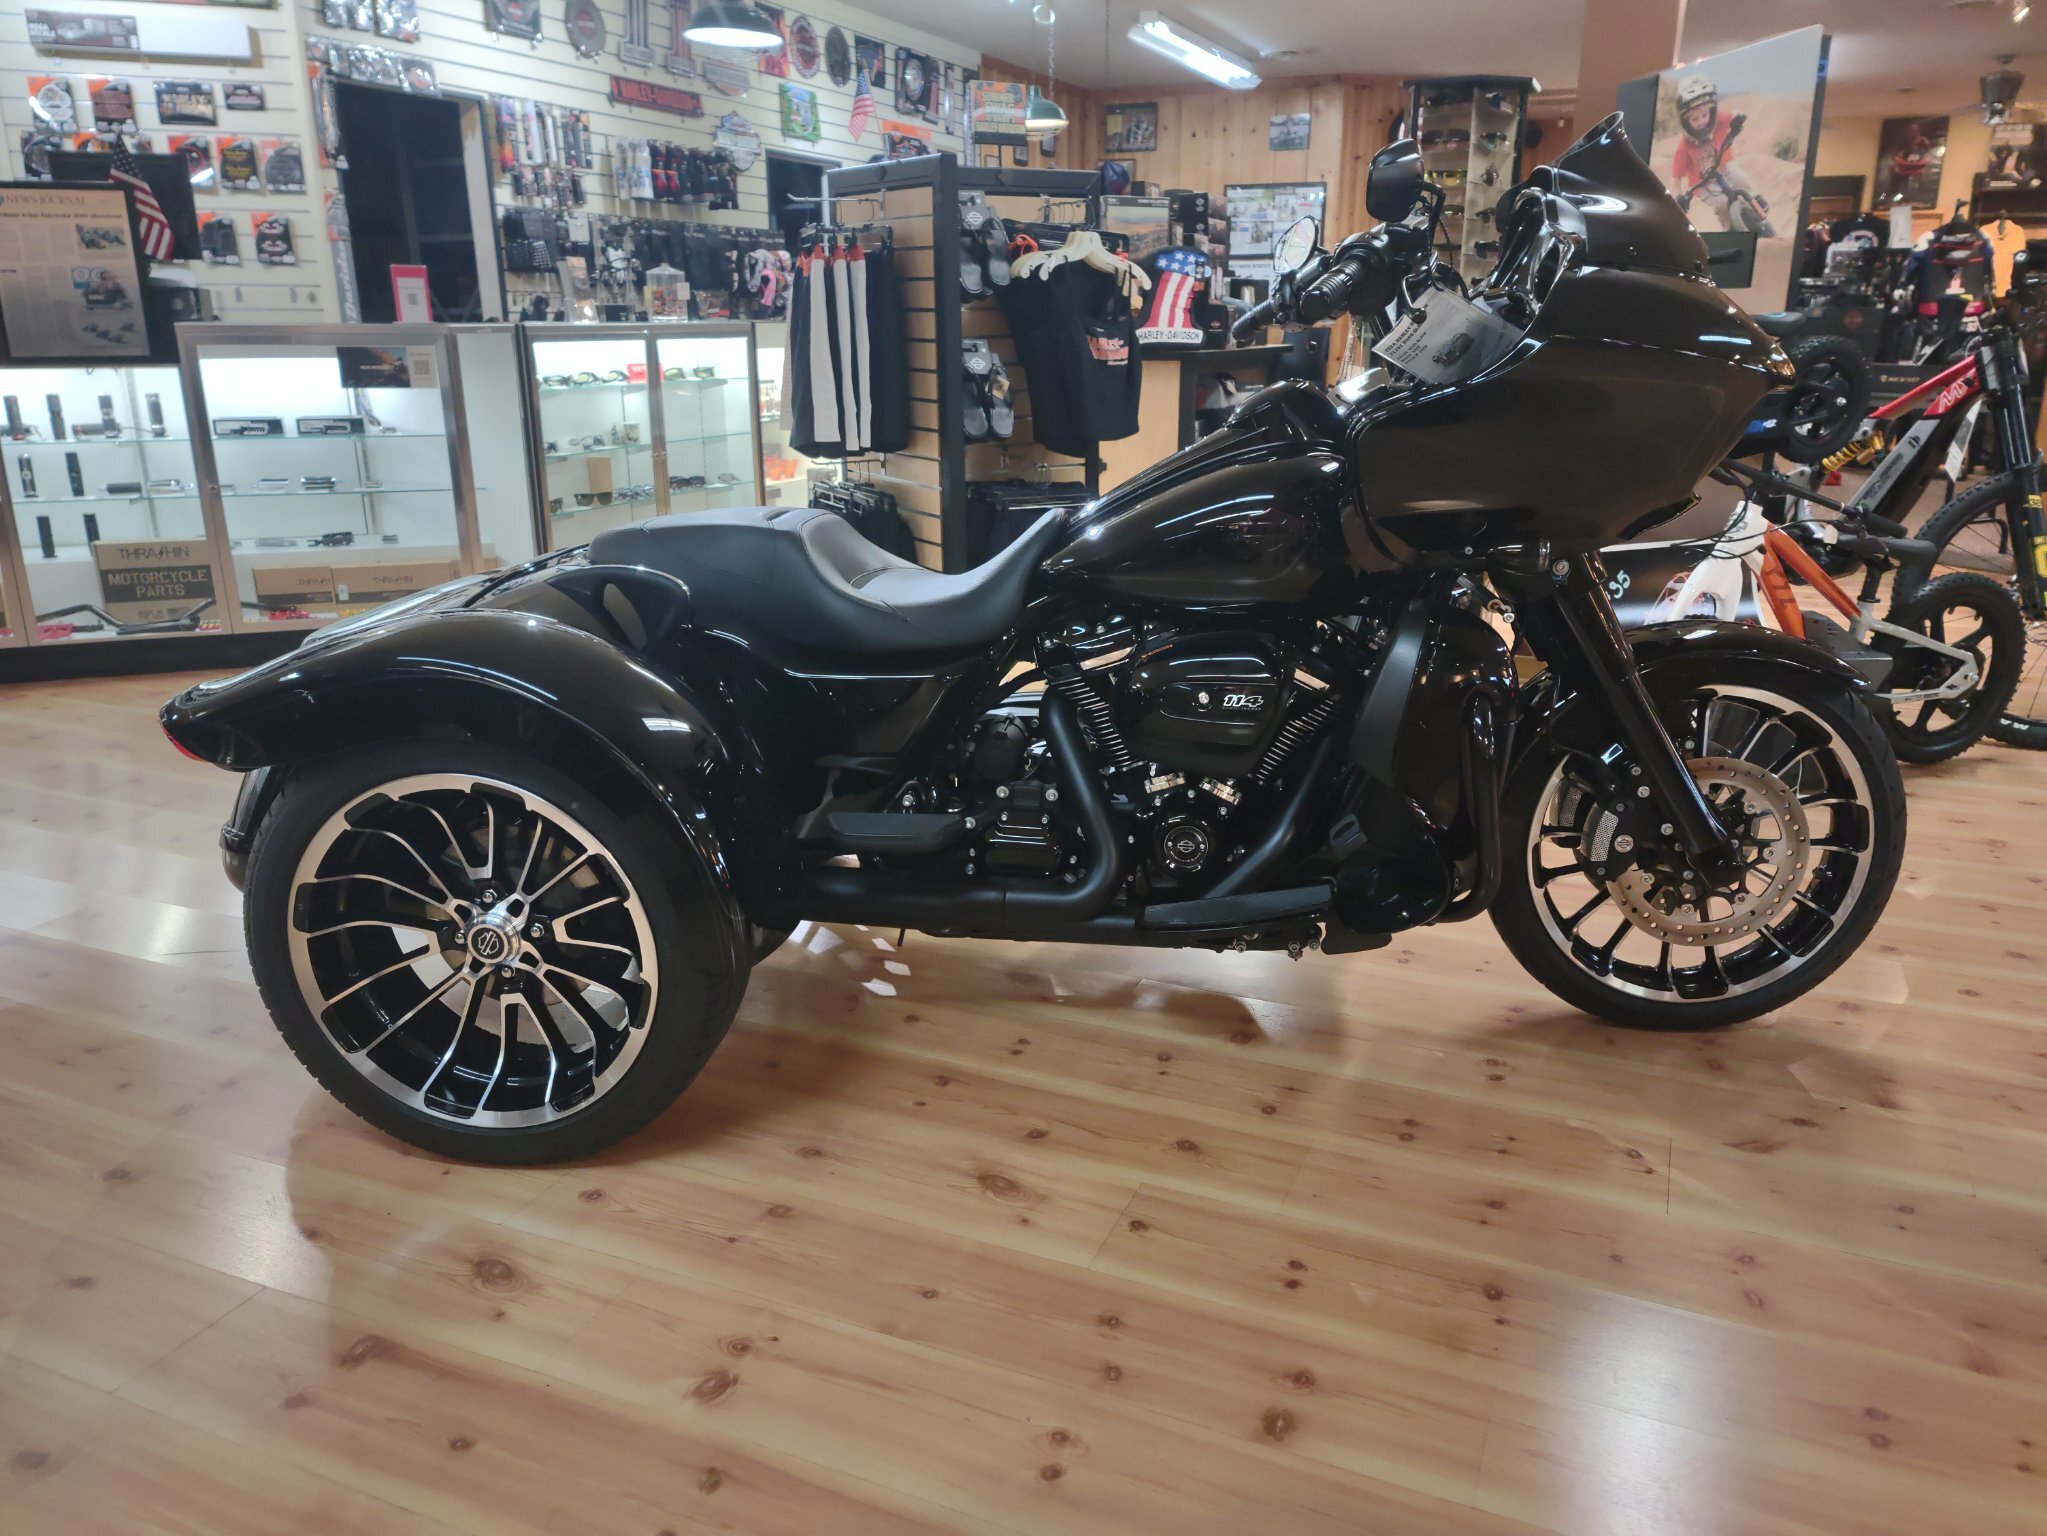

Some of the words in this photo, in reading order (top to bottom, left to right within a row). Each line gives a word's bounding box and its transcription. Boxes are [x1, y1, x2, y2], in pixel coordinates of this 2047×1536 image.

[1138, 330, 1200, 341] HARLEY-DAVIDSON
[108, 569, 208, 585] MOTORCYCLE
[136, 584, 185, 598] PARTS
[1223, 694, 1264, 707] 114
